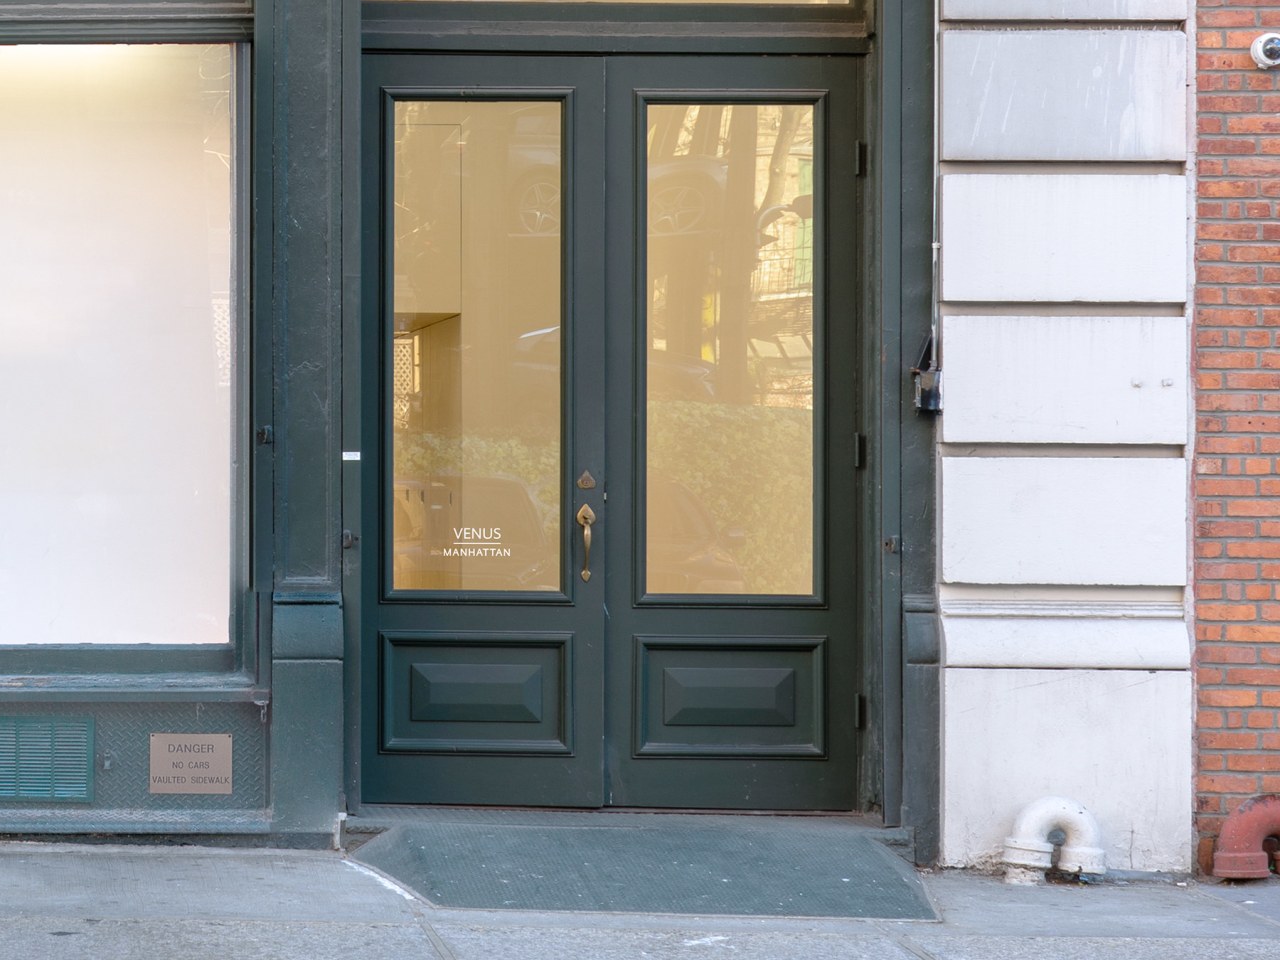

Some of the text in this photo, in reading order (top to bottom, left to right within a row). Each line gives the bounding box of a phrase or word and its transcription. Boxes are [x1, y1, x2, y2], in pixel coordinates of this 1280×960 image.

[453, 527, 502, 540] VENUS
[443, 548, 511, 557] MANHATTAN
[167, 743, 215, 754] DANGER
[172, 761, 210, 769] NO CARS
[152, 776, 230, 784] VAULTED SIDEWALK
